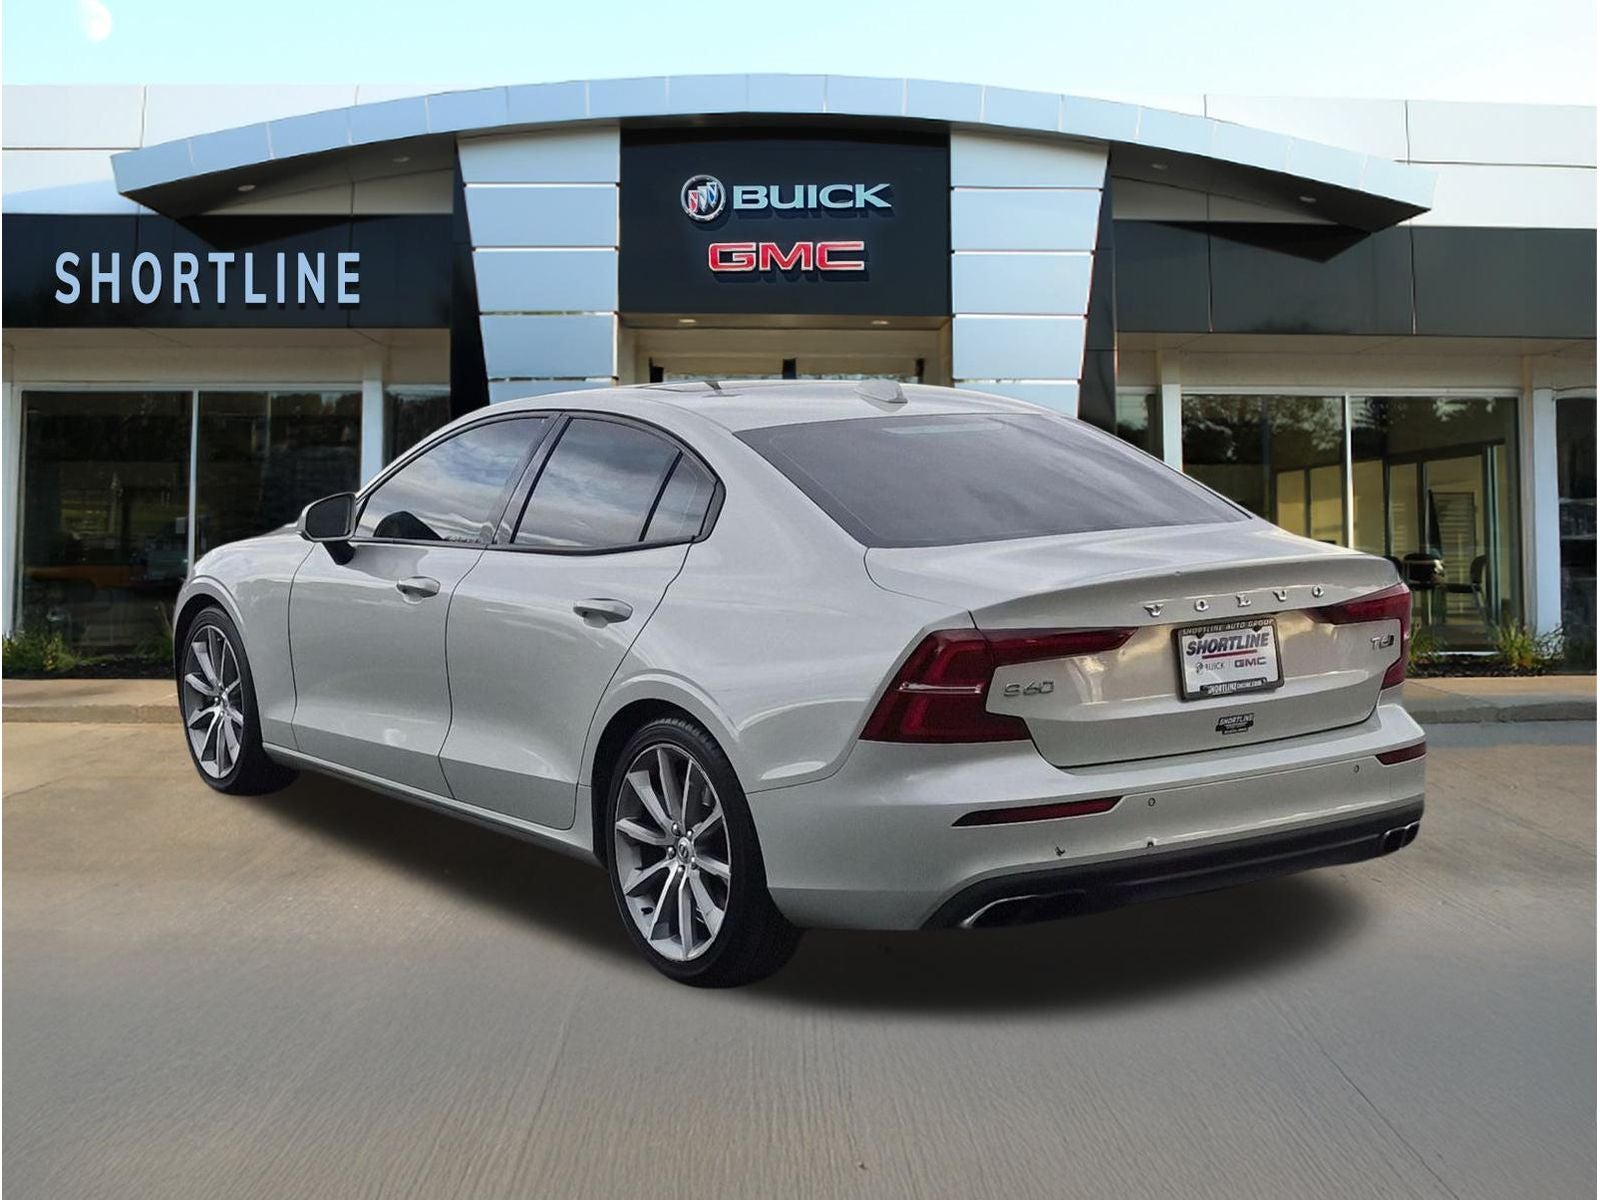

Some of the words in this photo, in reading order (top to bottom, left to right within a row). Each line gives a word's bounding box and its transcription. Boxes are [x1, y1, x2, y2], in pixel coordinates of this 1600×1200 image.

[732, 183, 893, 210] BUICK
[708, 240, 865, 272] GMC
[54, 251, 361, 305] SHORTLINE
[1144, 585, 1325, 617] VOLVO
[1183, 625, 1222, 635] SHORTLINE
[1226, 622, 1246, 630] AUTO
[1248, 619, 1274, 627] GROUP
[1186, 632, 1270, 655] SHORTLINE
[1204, 661, 1225, 671] BUICK
[1234, 656, 1267, 669] GMC
[1003, 680, 1055, 697] S60
